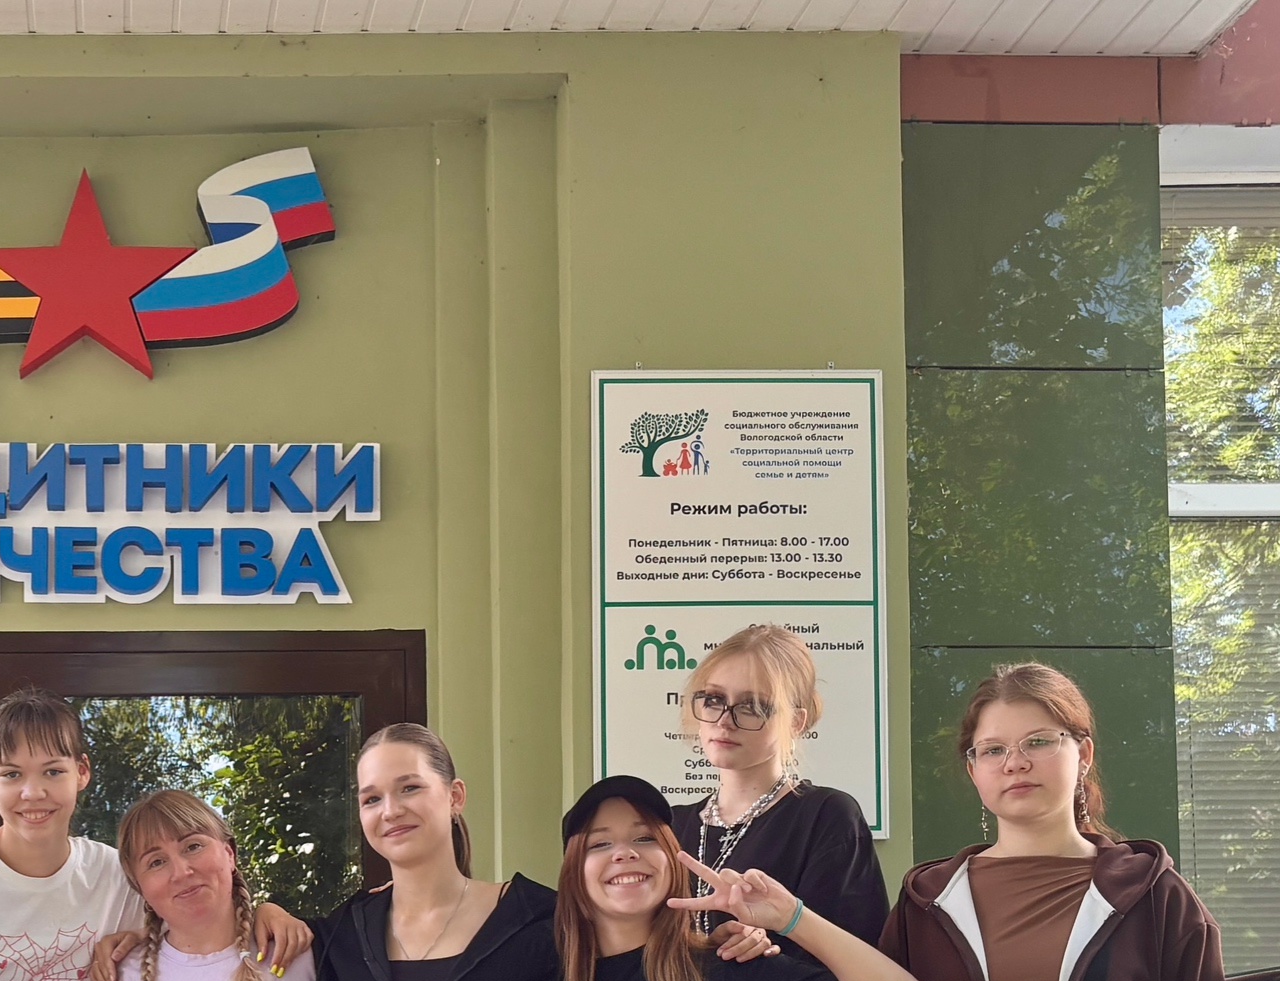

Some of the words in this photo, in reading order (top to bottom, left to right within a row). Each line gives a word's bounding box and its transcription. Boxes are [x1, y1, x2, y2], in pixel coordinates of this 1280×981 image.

[732, 410, 788, 419] Бюджетное
[790, 411, 851, 420] учреждение
[724, 421, 787, 430] социального
[788, 421, 859, 431] обслуживания
[740, 433, 803, 442] Вологодской
[805, 433, 844, 442] области
[730, 446, 823, 456] «Территориальный
[825, 448, 854, 456] центр
[742, 458, 800, 467] социальной
[802, 460, 842, 468] помощи
[795, 471, 830, 479] детям»
[670, 502, 732, 516] Режим
[737, 500, 808, 517] работы:
[628, 538, 711, 548] Понедельник
[722, 537, 778, 548] Пятница:
[780, 537, 808, 547] 8.00
[818, 536, 850, 547] 17.00
[635, 553, 707, 564] Обеденный
[711, 555, 768, 565] перерыв:
[770, 553, 802, 563] 13.00
[813, 553, 843, 563] 13.30
[616, 570, 680, 580] Выходные
[682, 571, 709, 581] дни:
[711, 569, 765, 581] Суббота
[776, 569, 862, 581] Воскресенье
[684, 758, 715, 770] Субб
[685, 772, 703, 780] Без
